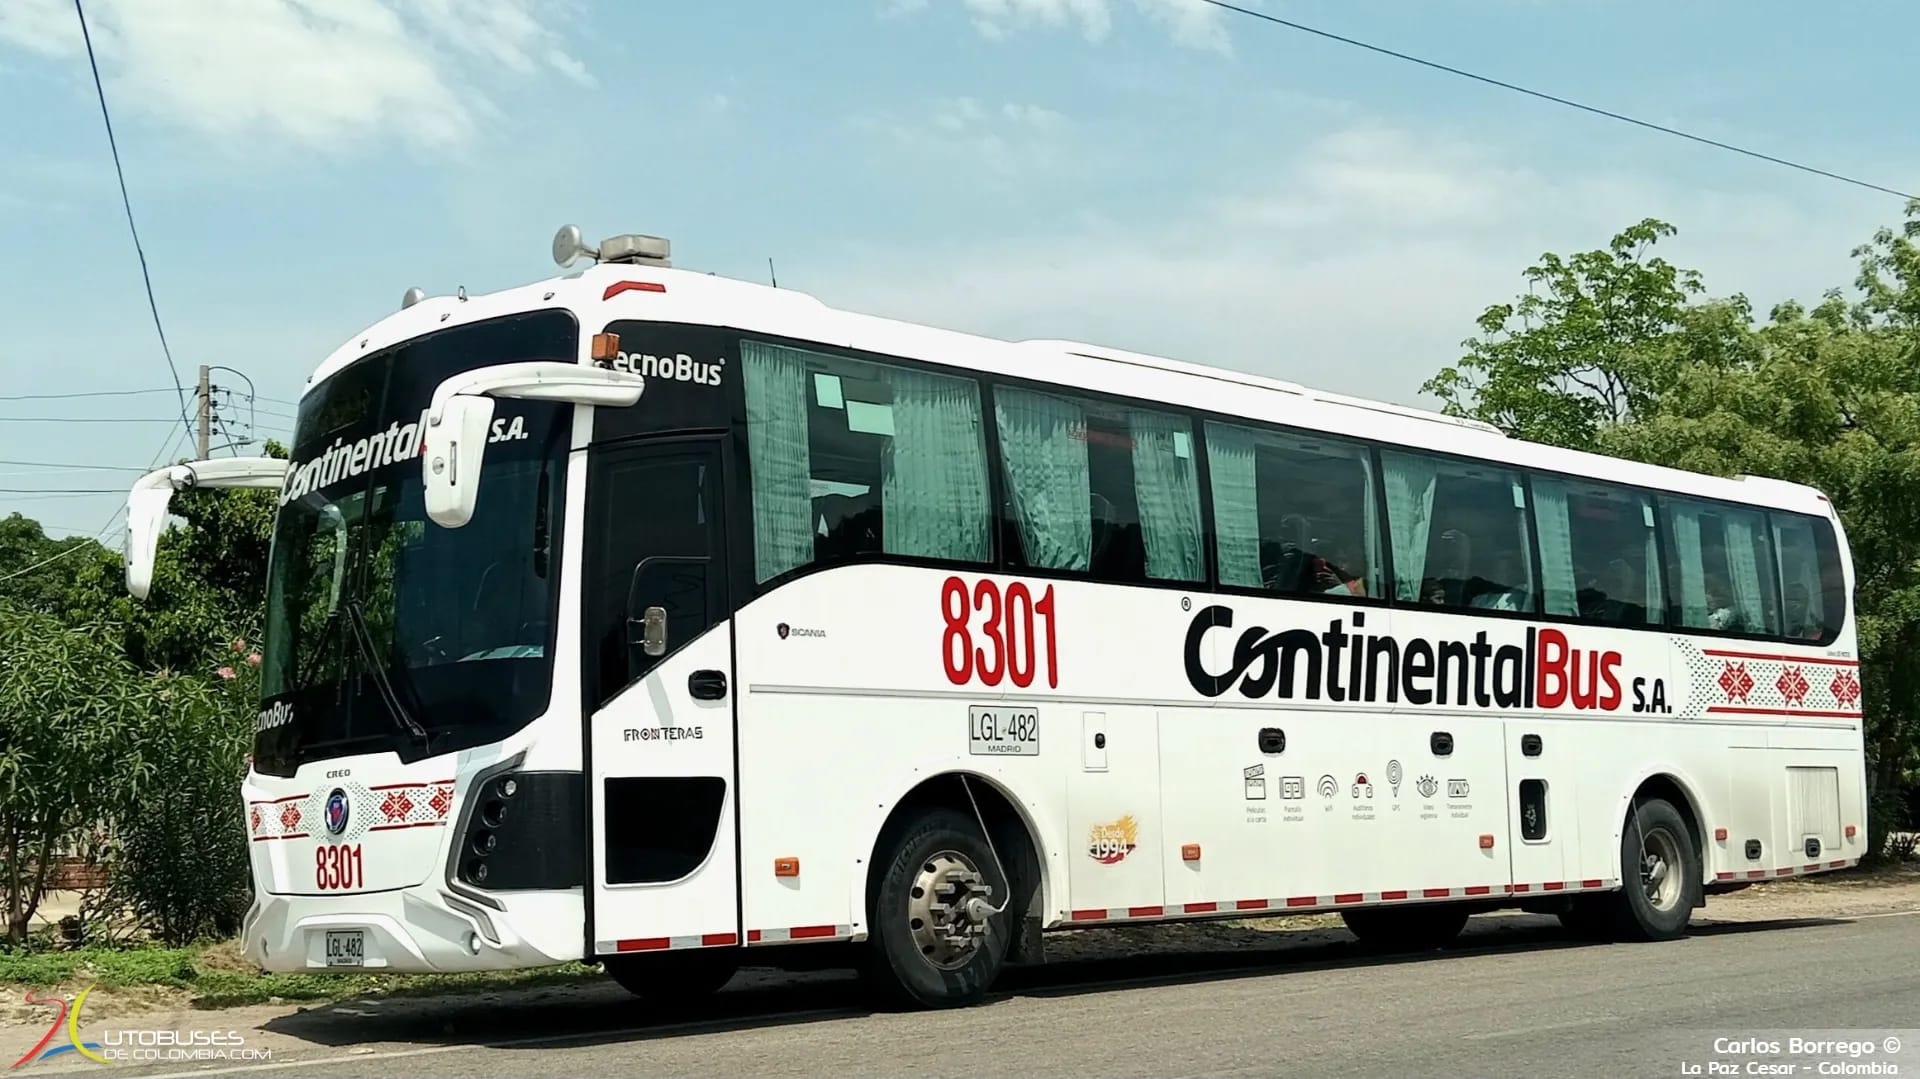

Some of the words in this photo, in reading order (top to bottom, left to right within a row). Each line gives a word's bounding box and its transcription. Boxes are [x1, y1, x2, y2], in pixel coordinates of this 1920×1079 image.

[612, 350, 725, 386] ecnoBus
[279, 408, 429, 507] Continental
[489, 416, 529, 443] S.A.
[791, 628, 826, 638] SCANIA
[941, 576, 1058, 689] 8301
[1184, 604, 1623, 711] ContinentalBus
[1632, 676, 1672, 714] S.A.
[623, 726, 703, 742] FRONTERAS
[988, 745, 1021, 753] MADRID
[326, 769, 351, 779] CREO
[1096, 838, 1127, 858] 1994
[316, 843, 363, 890] 8301
